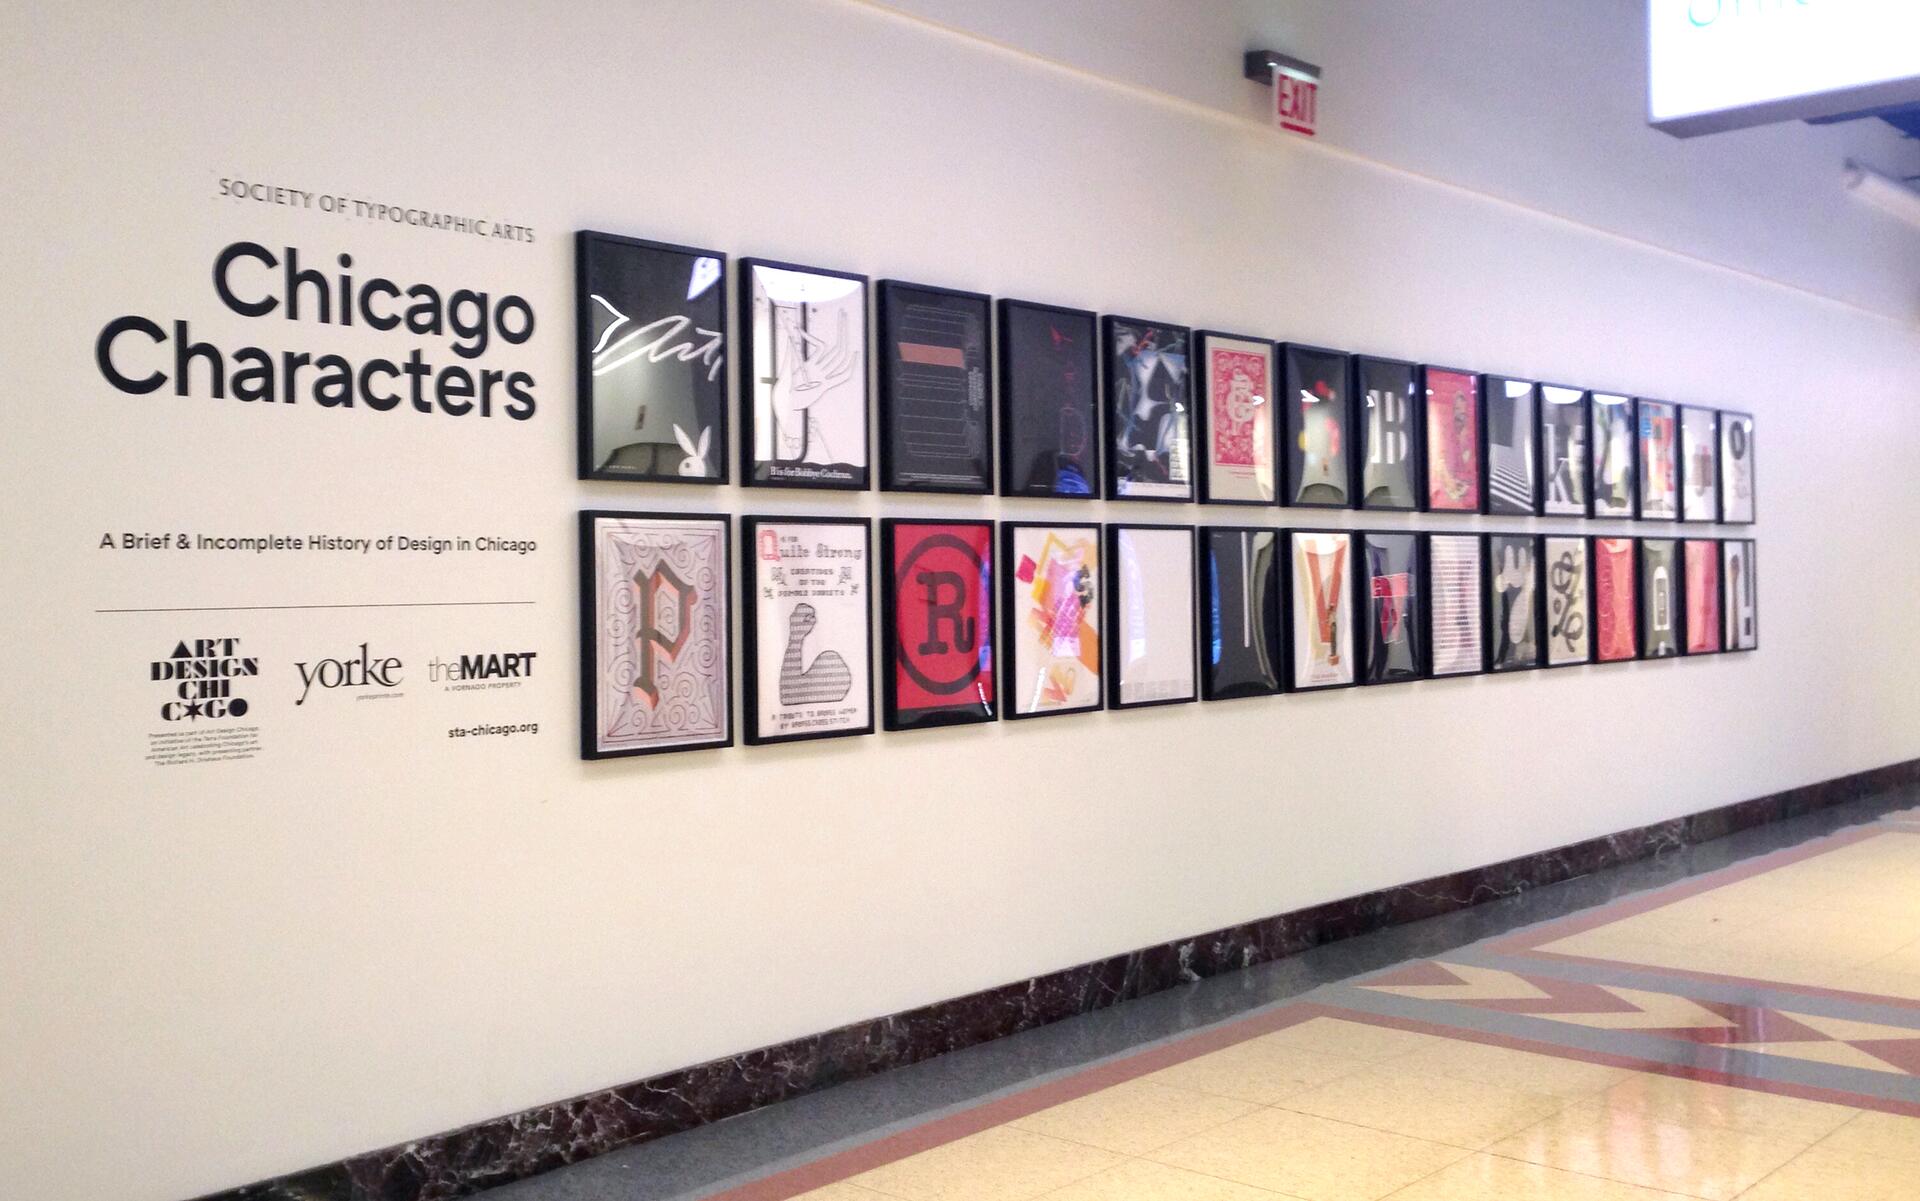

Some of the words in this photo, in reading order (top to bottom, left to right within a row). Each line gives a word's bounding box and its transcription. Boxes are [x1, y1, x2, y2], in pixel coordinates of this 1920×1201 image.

[1278, 73, 1318, 124] EXIT
[218, 177, 315, 209] SOCIETY
[318, 194, 349, 214] OF
[351, 199, 489, 237] TYPOGRAPHIC
[491, 221, 536, 243] ARTS
[212, 241, 535, 359] Chicago
[95, 315, 536, 421] Characters
[100, 533, 115, 549] A
[122, 533, 171, 549] Brief
[176, 533, 190, 549] &
[197, 534, 303, 554] Incomplete
[309, 535, 371, 554] History
[375, 535, 393, 550] of
[397, 536, 451, 555] Design
[457, 536, 471, 551] in
[475, 537, 537, 555] Chicago
[169, 638, 240, 658] ART
[150, 658, 259, 681] DESIGN
[293, 642, 404, 706] yorke
[177, 679, 230, 700] CHI
[488, 681, 521, 690] PROPERTY
[447, 722, 539, 738] sta-chicago.org
